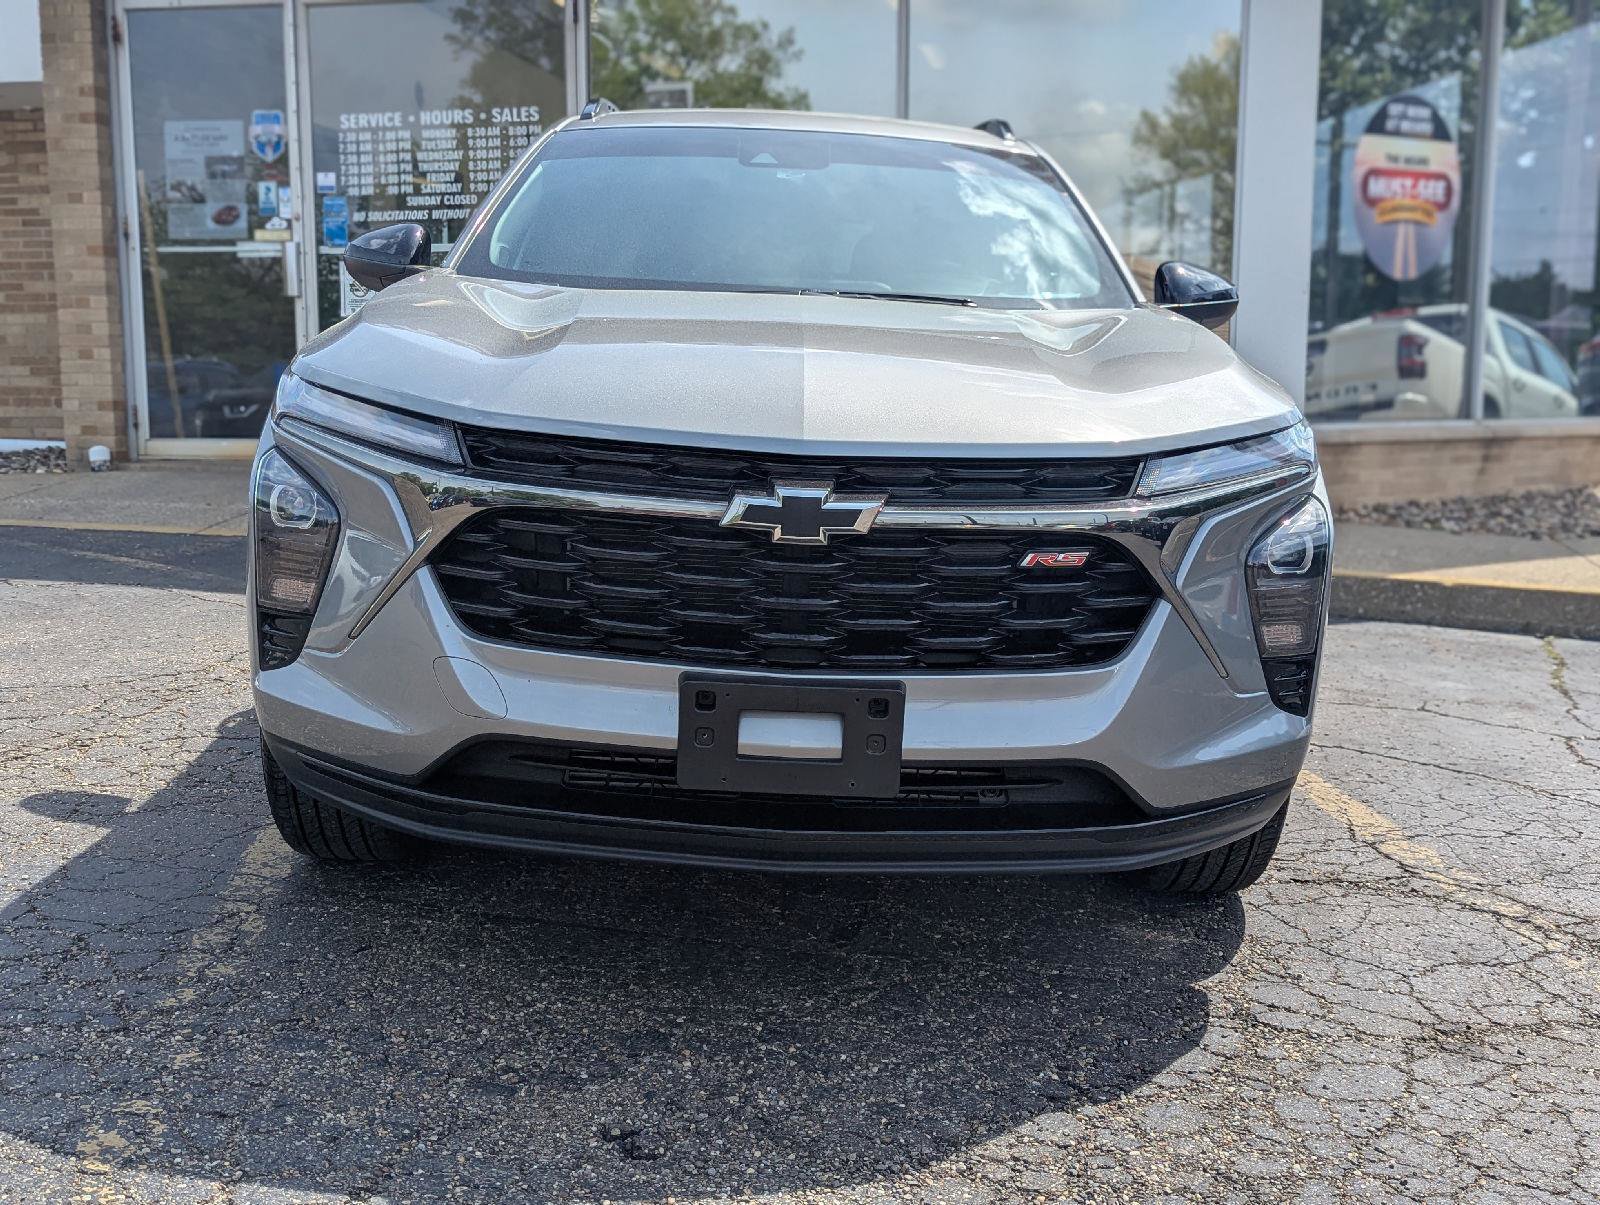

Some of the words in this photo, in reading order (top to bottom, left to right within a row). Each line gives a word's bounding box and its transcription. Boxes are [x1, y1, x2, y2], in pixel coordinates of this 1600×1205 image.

[340, 112, 402, 129] SERVICE
[420, 109, 473, 126] HOURS
[492, 106, 539, 122] SALES
[359, 132, 371, 141] AM
[398, 129, 411, 140] PM
[422, 127, 457, 138] MONDAY
[467, 127, 486, 137] 8:30
[487, 126, 500, 136] AM
[508, 125, 527, 135] 8:00
[528, 124, 541, 134] PM
[359, 142, 372, 152] AM
[399, 141, 411, 151] PM
[421, 139, 457, 150] TUESDAY
[468, 138, 487, 148] 9:00
[487, 137, 501, 147] AM
[509, 136, 528, 147] 6:00
[360, 153, 373, 163] AM
[399, 151, 412, 161] PM
[416, 150, 464, 161] WEDNESDAY
[468, 149, 487, 159] 9:00
[488, 148, 501, 159] AM
[361, 164, 373, 174] AM
[400, 162, 412, 172] PM
[418, 161, 460, 172] THURSDAY
[468, 160, 487, 170] 8:30
[488, 160, 501, 170] AM
[361, 175, 374, 185] AM
[400, 173, 413, 184] PM
[426, 172, 456, 183] FRIDAY
[469, 171, 488, 181] 9:00
[401, 184, 413, 194] PM
[421, 182, 462, 193] SATURDAY
[469, 182, 488, 192] 9:00
[406, 196, 441, 206] SUNDAY
[444, 194, 477, 205] CLOSED
[353, 211, 366, 222] NO
[367, 210, 429, 221] SOLICITATIONS
[432, 208, 470, 219] WITHOUT
[1020, 552, 1090, 567] RS
